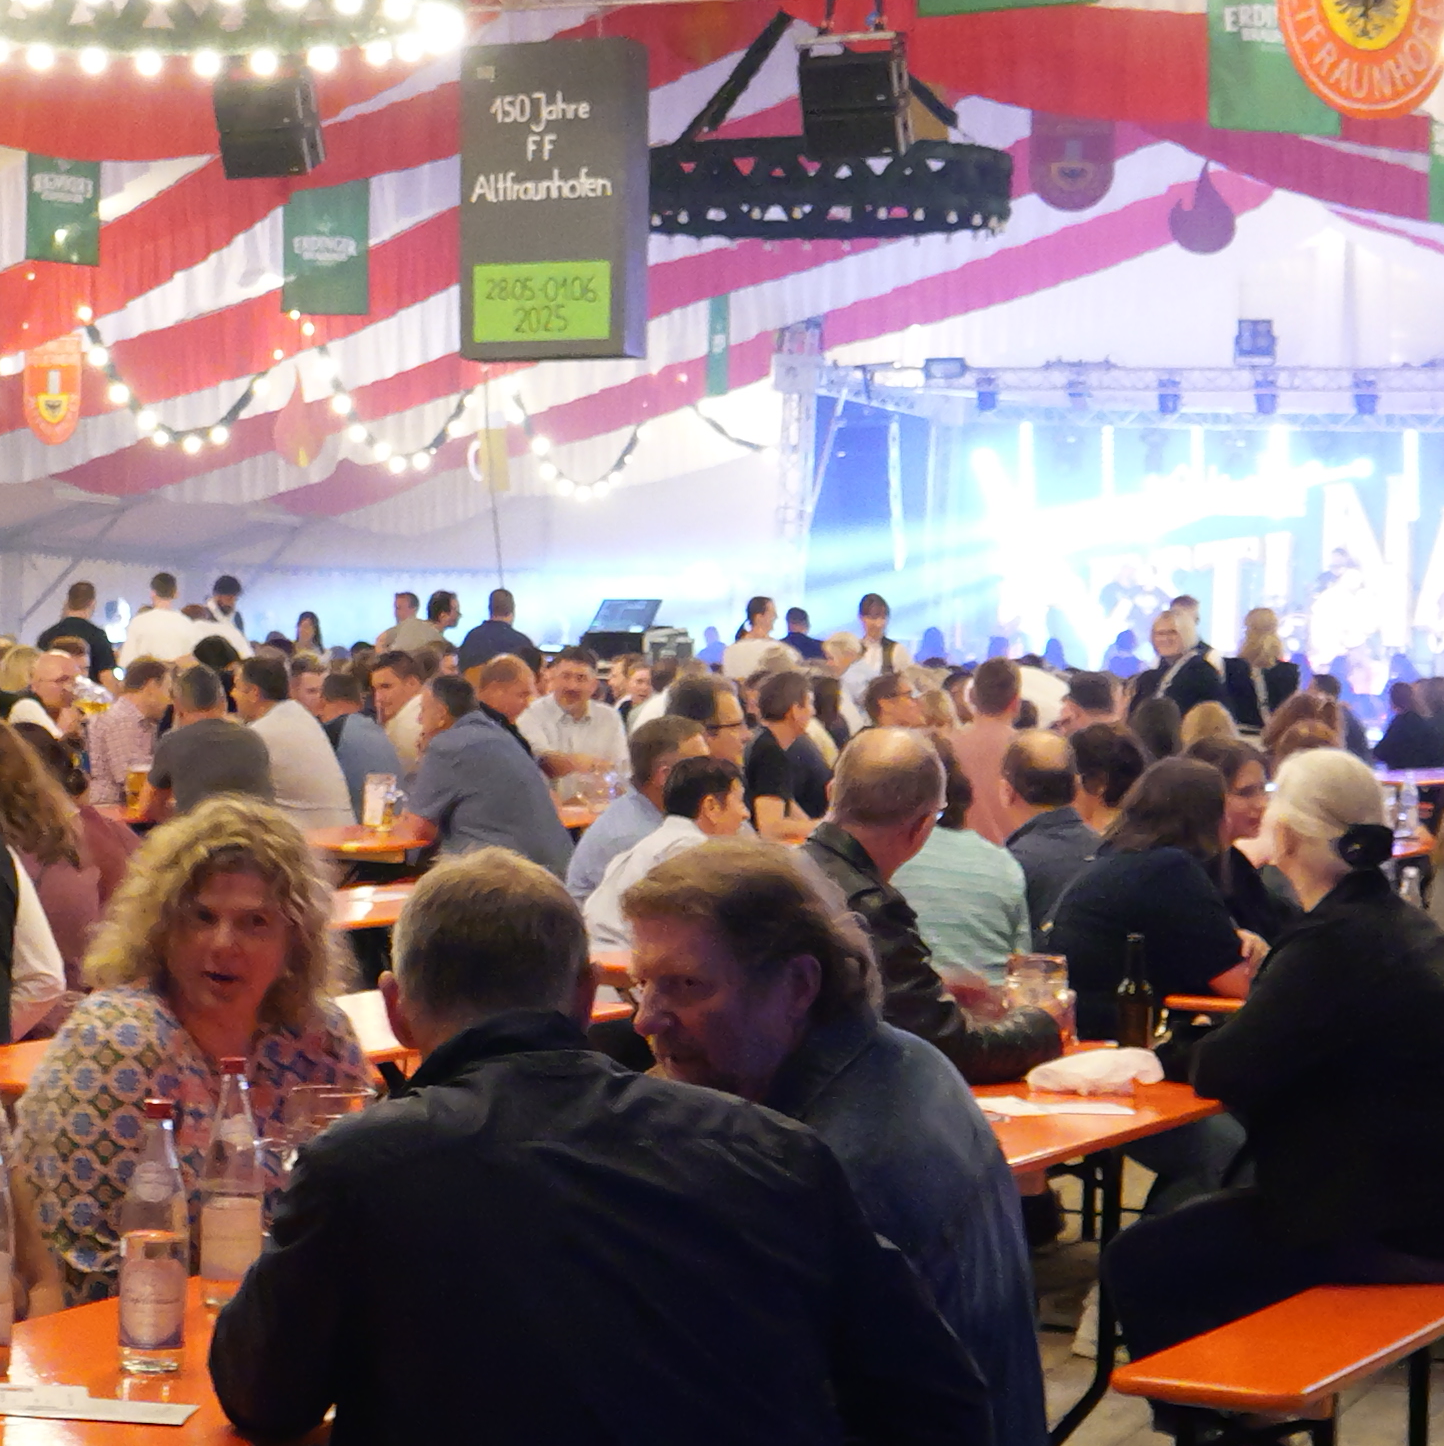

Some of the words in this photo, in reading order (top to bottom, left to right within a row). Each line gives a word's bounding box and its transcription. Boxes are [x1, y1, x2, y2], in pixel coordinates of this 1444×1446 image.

[490, 93, 530, 123] 150
[530, 90, 591, 132] Jahre
[470, 167, 612, 203] Altfraunhofen
[515, 304, 568, 334] 2025
